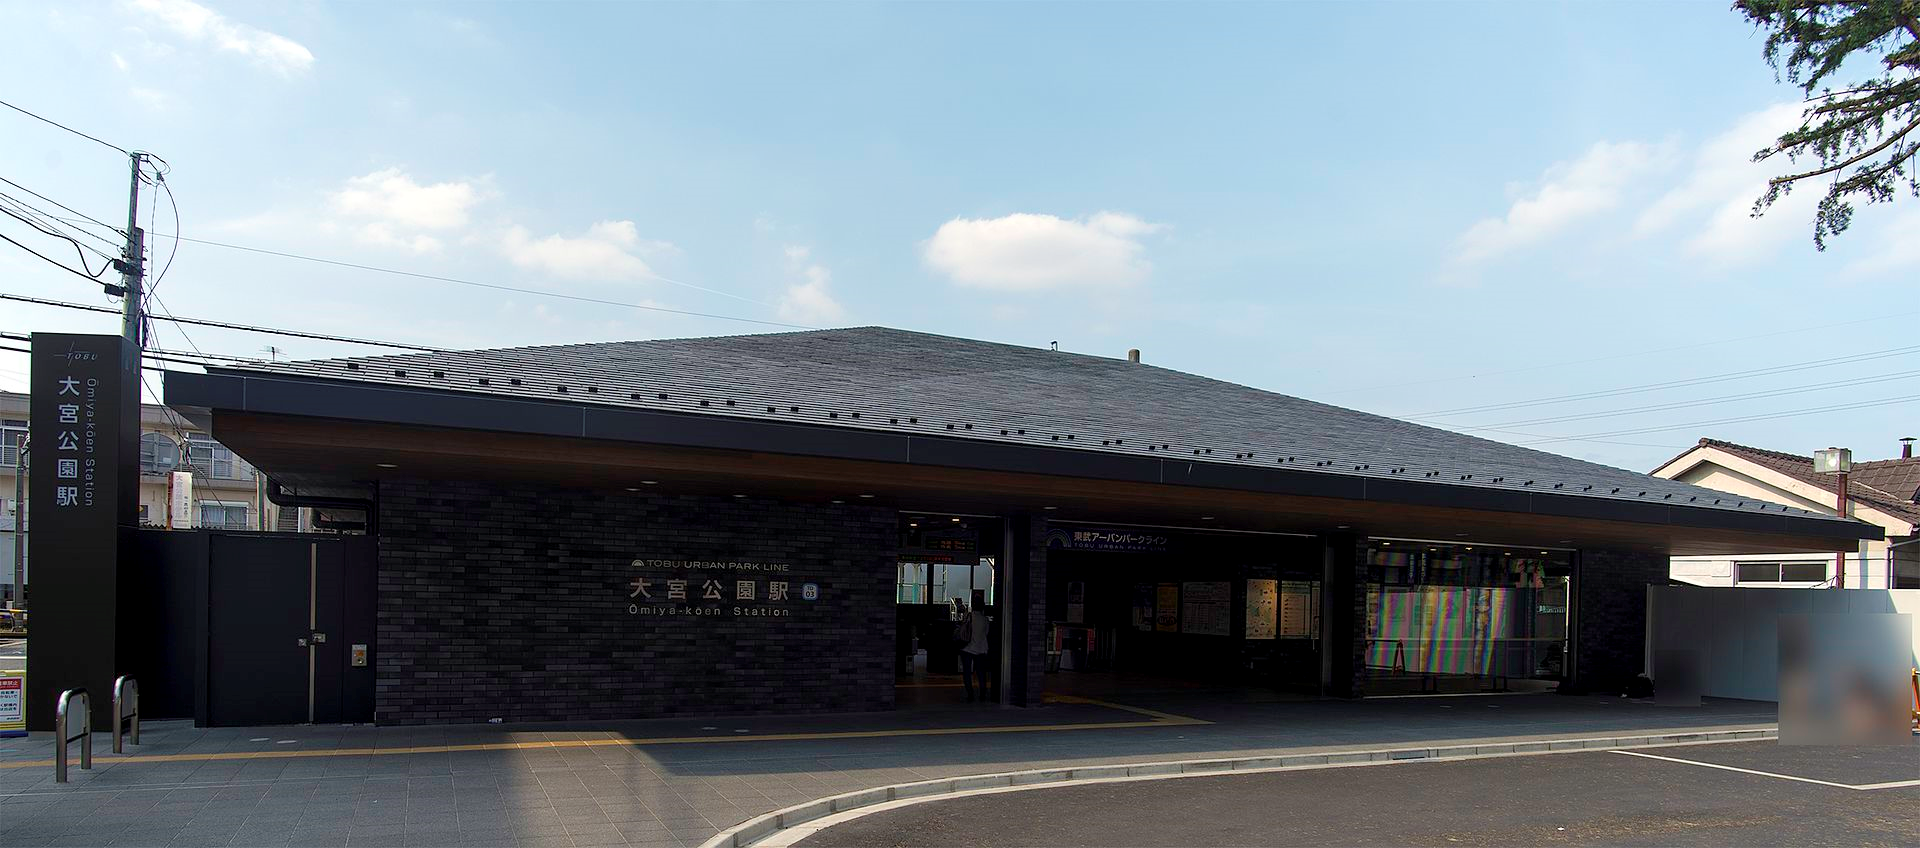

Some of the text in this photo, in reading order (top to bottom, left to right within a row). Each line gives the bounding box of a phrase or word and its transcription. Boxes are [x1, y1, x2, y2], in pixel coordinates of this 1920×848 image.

[66, 352, 98, 361] TOBU
[56, 376, 80, 507] 大宮公園駅
[84, 459, 96, 506] Station
[648, 560, 790, 571] TOBU URBAN PARK LINE
[630, 578, 789, 601] 大宮公園駅
[733, 606, 789, 616] Station
